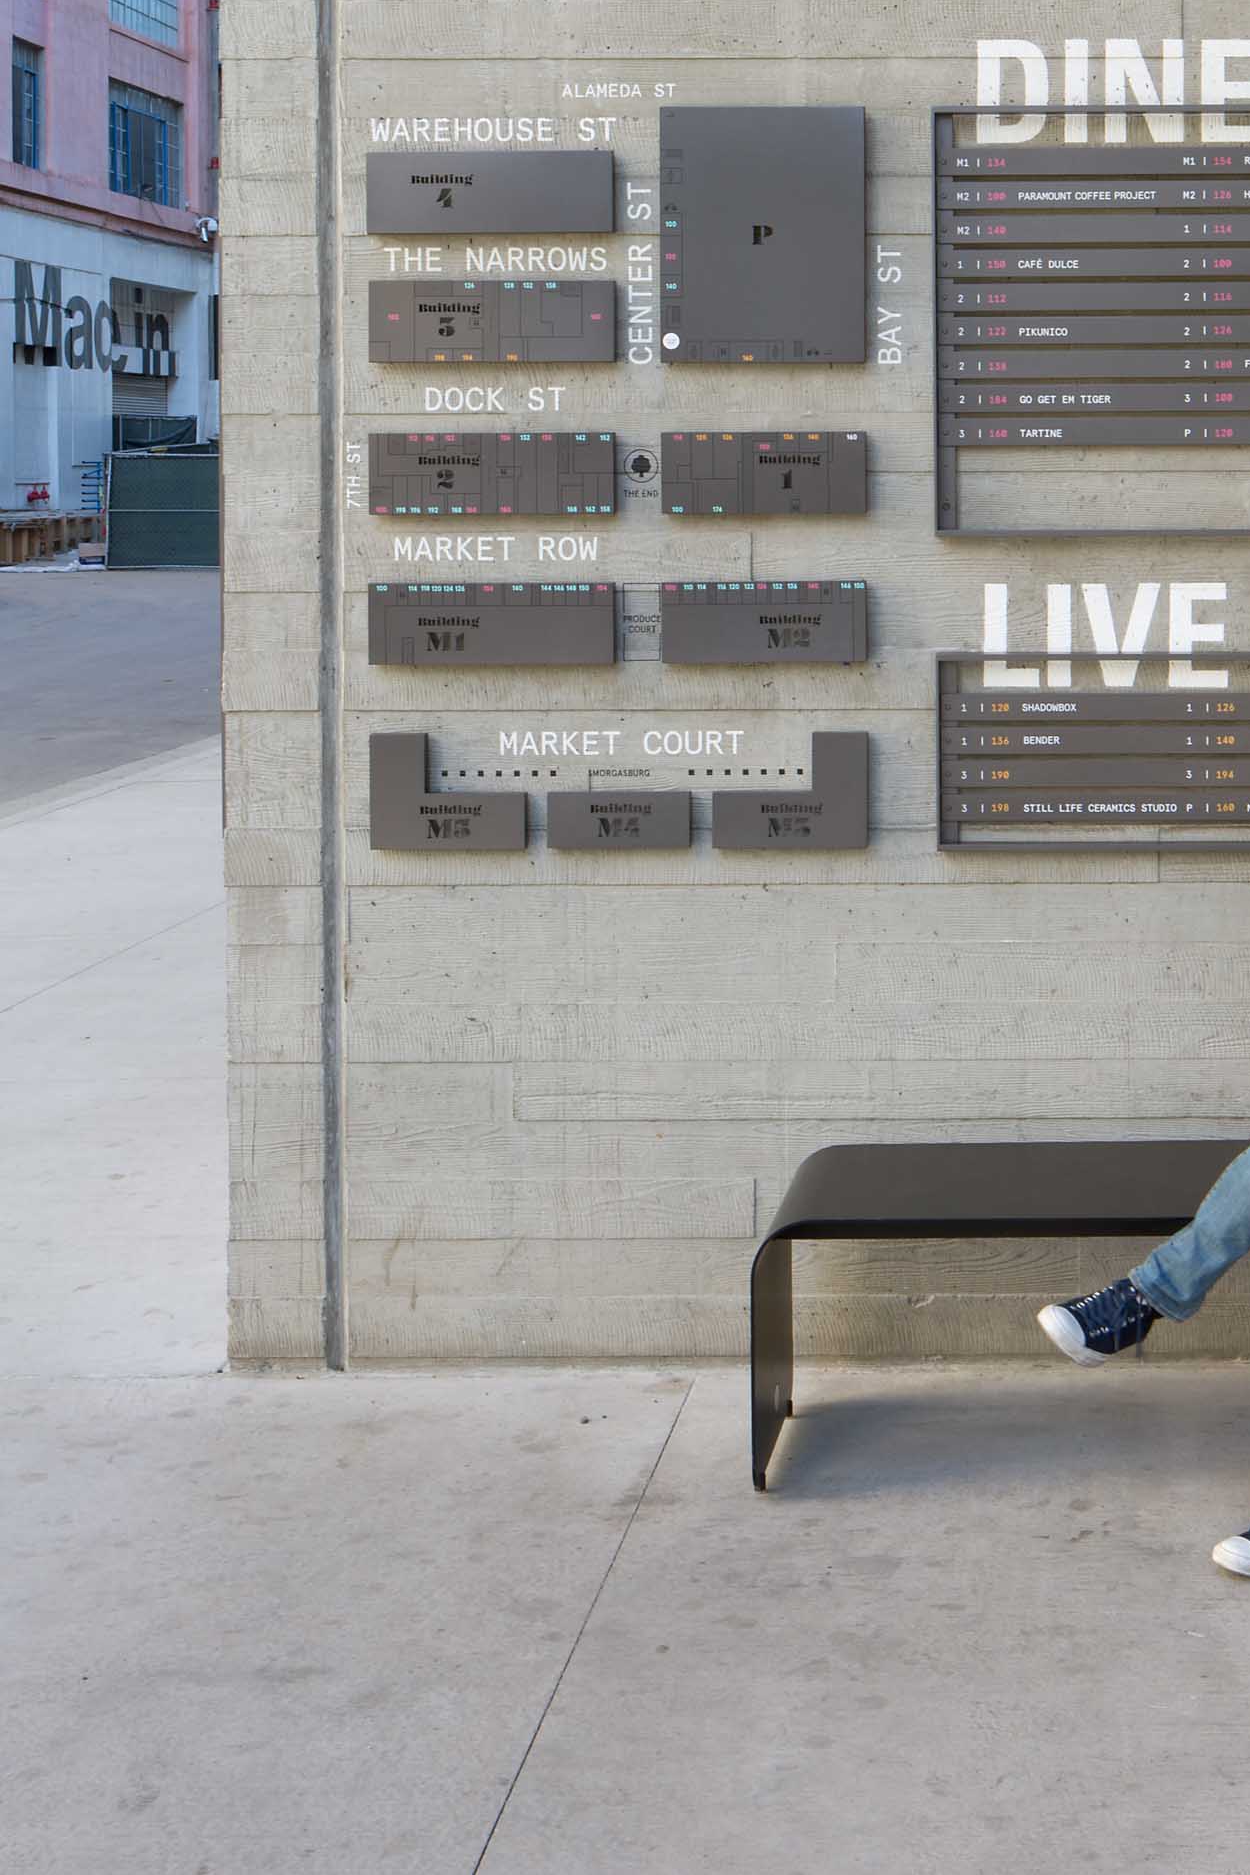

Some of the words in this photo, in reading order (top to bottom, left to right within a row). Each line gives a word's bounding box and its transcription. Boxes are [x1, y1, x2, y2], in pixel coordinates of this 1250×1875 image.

[562, 84, 641, 98] ALAMEDA
[654, 83, 676, 97] ST
[371, 117, 553, 142] WAREHOUSE
[578, 117, 616, 141] ST
[412, 174, 472, 185] Building
[627, 183, 651, 220] ST
[1018, 192, 1072, 200] PARAMOUNT
[1075, 192, 1111, 200] COFFEE
[1114, 191, 1156, 199] PROJECT
[384, 248, 441, 271] THE
[467, 248, 606, 271] NARROWS
[878, 245, 901, 283] ST
[1018, 258, 1042, 268] CAFÉ
[1048, 260, 1078, 268] DULCE
[418, 303, 480, 316] Building
[628, 244, 652, 364] CENTER
[878, 307, 902, 364] BAY
[1019, 328, 1068, 336] PIKUNICO
[425, 387, 504, 411] DOCK
[528, 387, 565, 411] ST
[1020, 395, 1032, 403] GO
[1038, 395, 1056, 404] GET
[1062, 395, 1074, 404] EM
[1080, 395, 1111, 404] TIGER
[1020, 429, 1062, 437] TARTINE
[347, 442, 360, 463] ST
[419, 453, 480, 466] Building
[760, 455, 820, 465] Building
[347, 471, 361, 508] 7TH
[394, 537, 515, 561] MARKET
[539, 537, 597, 560] ROW
[983, 583, 1228, 687] LIVE
[1022, 703, 1076, 712] SHADOWBOX
[500, 731, 621, 755] MARKET
[644, 731, 744, 754] COURT
[1024, 736, 1060, 744] BENDER
[1024, 804, 1053, 812] STILL
[1059, 804, 1083, 812] LIFE
[1088, 804, 1136, 812] CERAMICS
[1141, 804, 1177, 812] STUDIO
